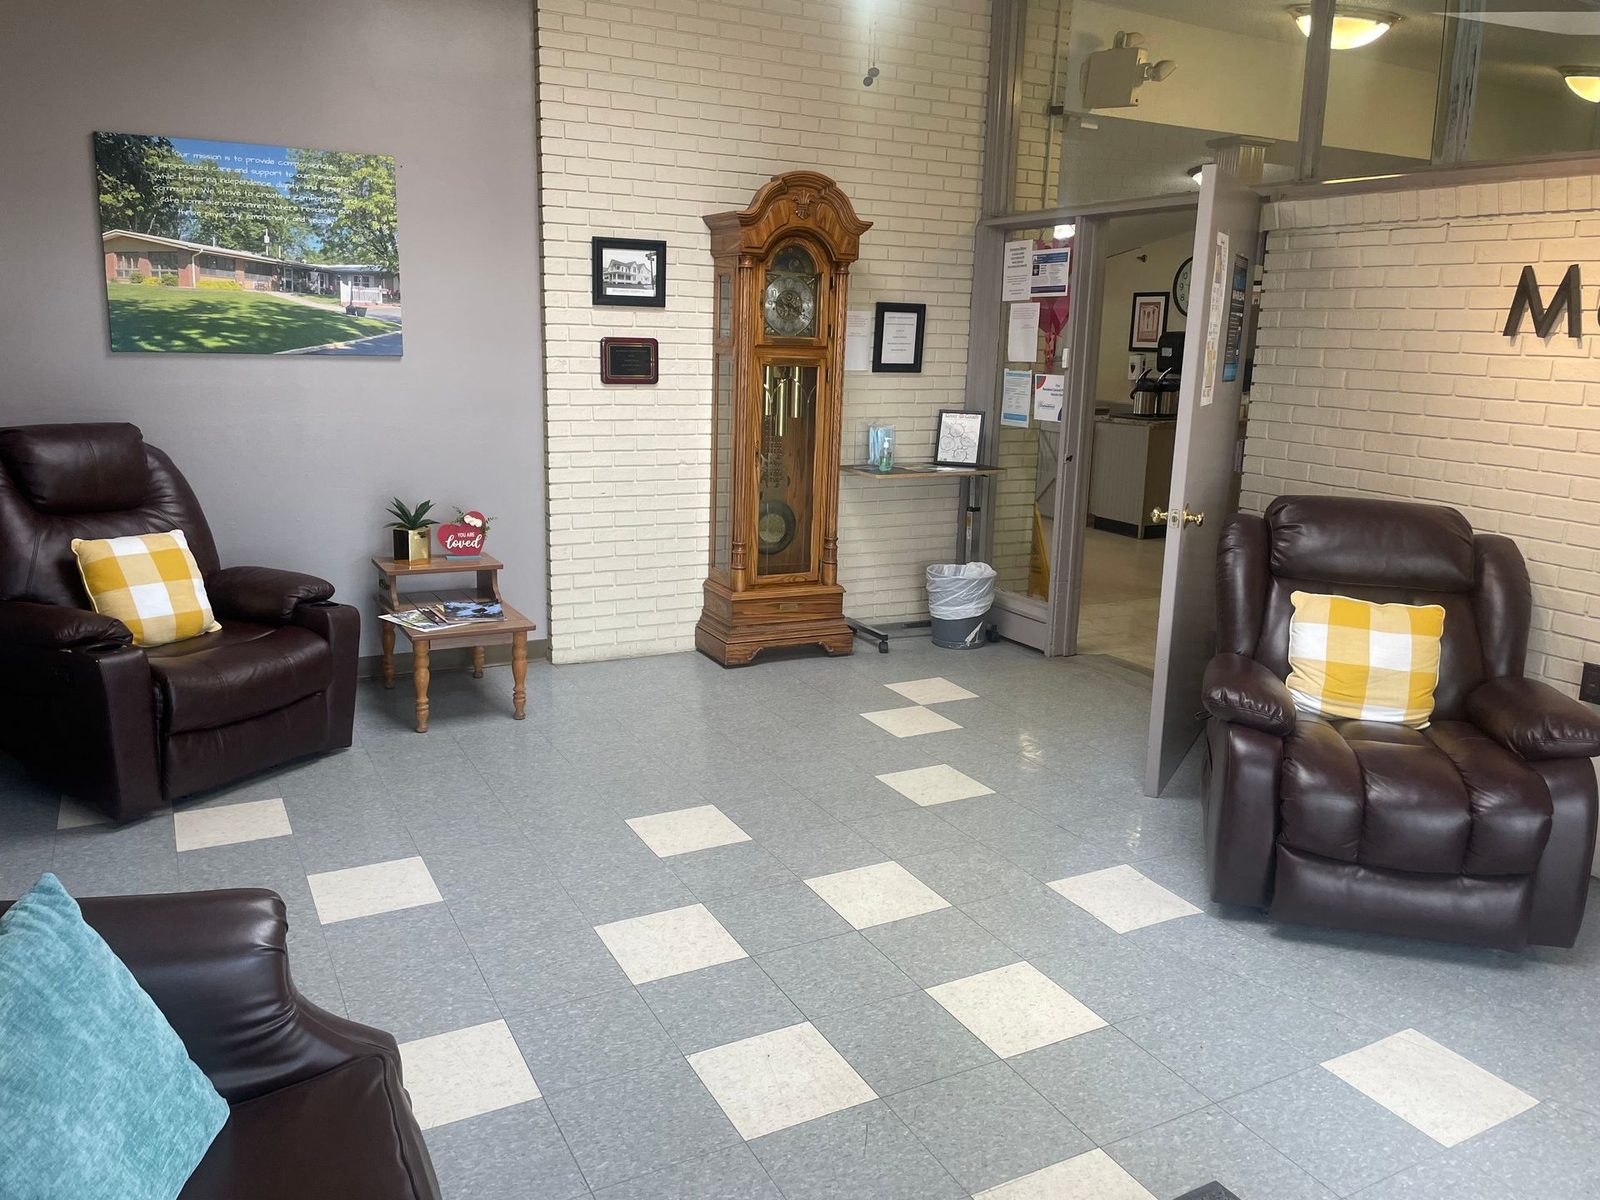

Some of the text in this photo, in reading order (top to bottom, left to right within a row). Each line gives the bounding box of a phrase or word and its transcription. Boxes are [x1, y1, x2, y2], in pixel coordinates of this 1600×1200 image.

[245, 157, 275, 165] provide
[251, 168, 282, 178] support
[178, 172, 218, 186] fostering
[303, 182, 318, 190] and
[255, 191, 283, 199] create
[222, 201, 270, 209] environment
[292, 215, 305, 223] and
[1503, 263, 1600, 339] M
[445, 534, 483, 549] loved
